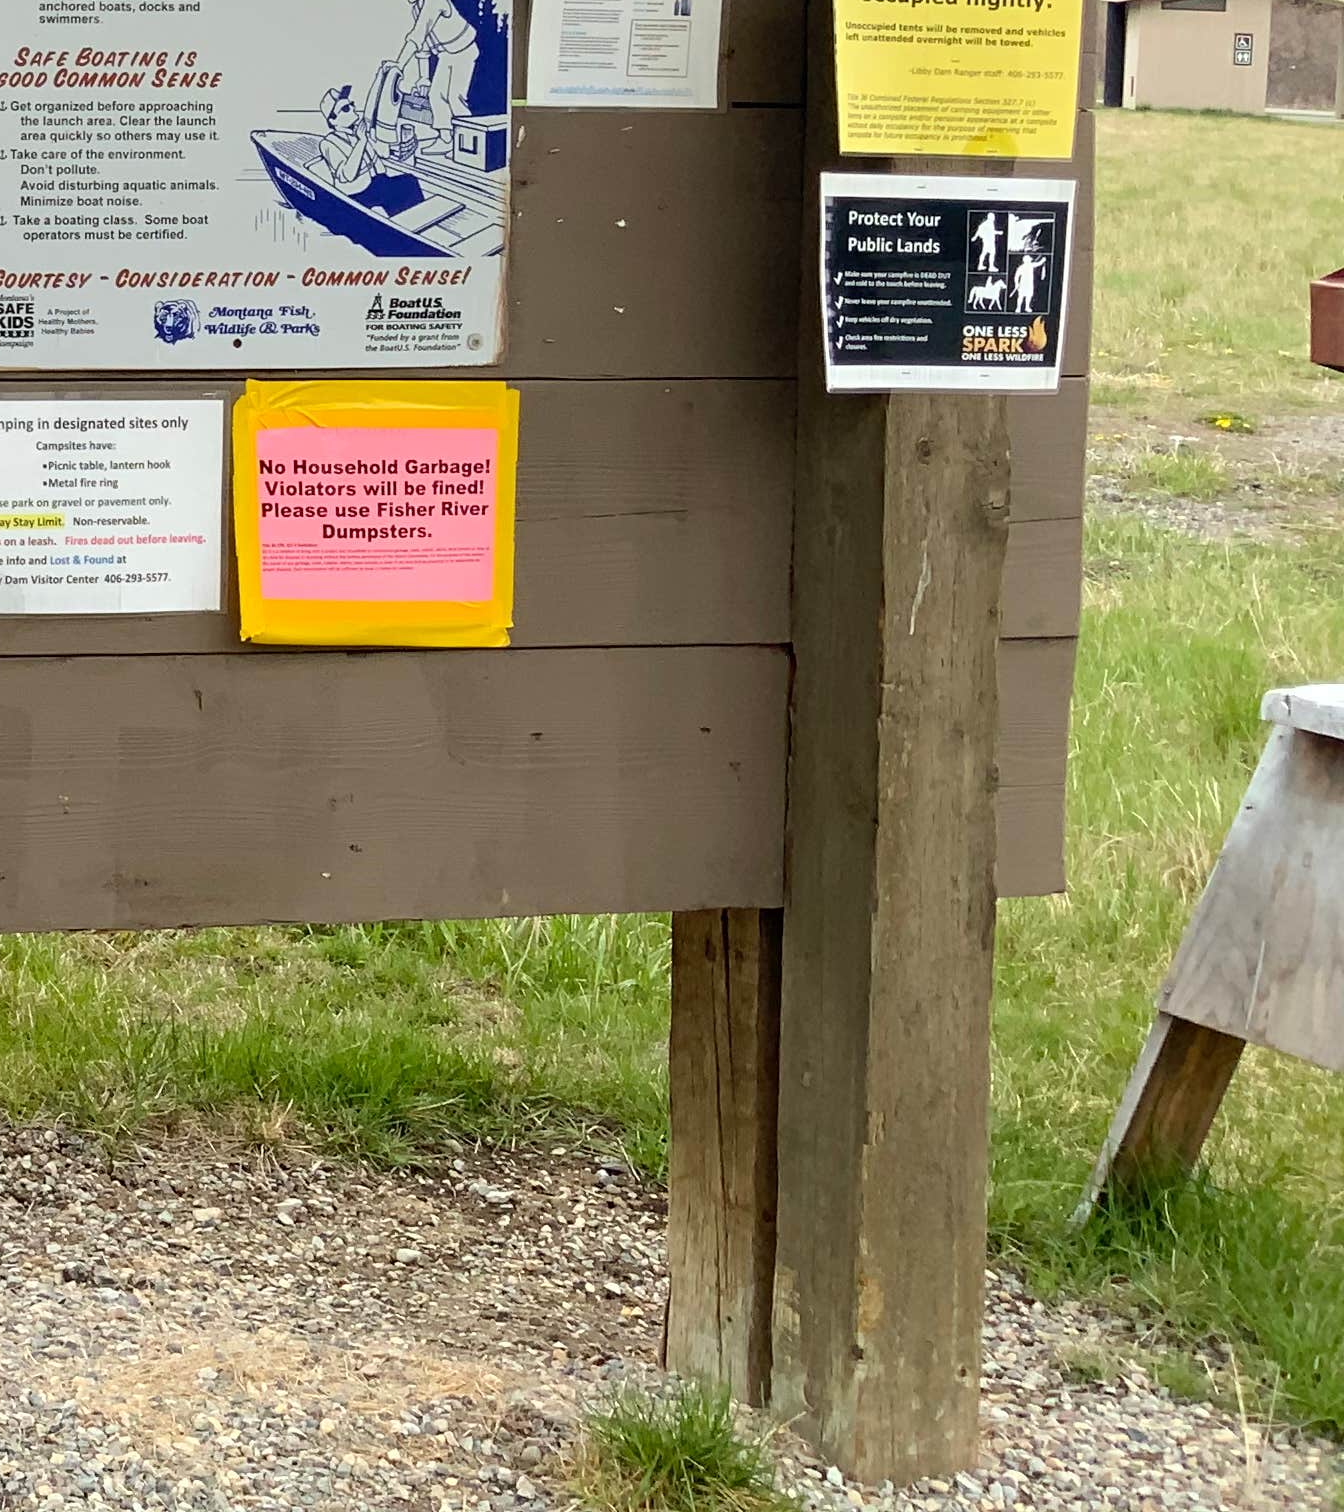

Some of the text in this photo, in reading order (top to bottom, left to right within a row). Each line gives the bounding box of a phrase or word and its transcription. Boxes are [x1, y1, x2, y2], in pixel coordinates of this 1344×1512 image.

[14, 46, 197, 69] SAFE BOATING IS
[848, 210, 941, 227] Protect Your
[848, 236, 940, 253] Public Lands
[208, 306, 273, 320] Montana
[387, 308, 461, 319] Foundation
[203, 322, 256, 337] Wildlife
[280, 323, 320, 336] Parks
[962, 325, 1027, 337] ONE LESS
[962, 337, 1023, 352] SPARK
[961, 352, 1043, 361] ONE LESS WILDFIRE
[37, 417, 49, 429] in
[53, 416, 125, 432] designated
[129, 416, 158, 429] sites
[161, 415, 188, 431] only
[259, 458, 490, 477] No Household Garbage!
[264, 479, 483, 496] Violators will be fined!
[261, 501, 489, 517] Please use Fisher River
[322, 523, 432, 542] Dumpsters.
[4, 575, 28, 585] Dam
[30, 574, 63, 584] Visitor
[66, 574, 99, 584] Center
